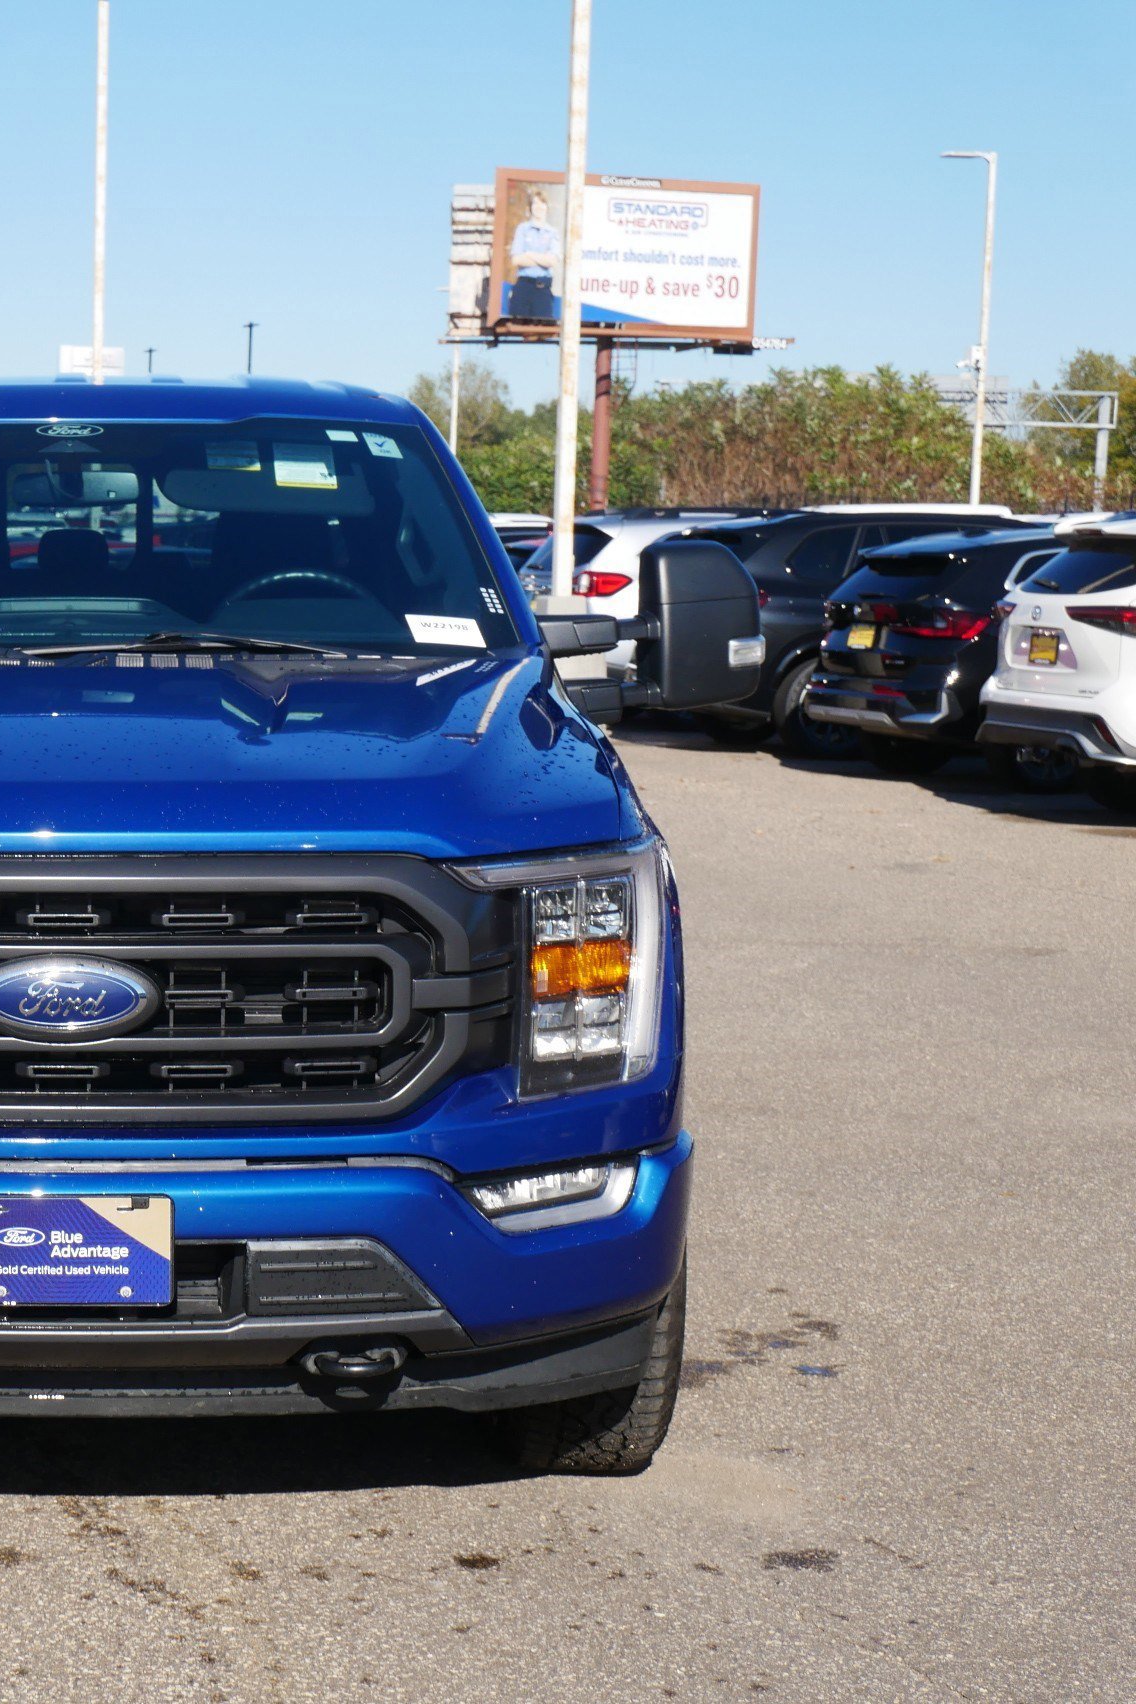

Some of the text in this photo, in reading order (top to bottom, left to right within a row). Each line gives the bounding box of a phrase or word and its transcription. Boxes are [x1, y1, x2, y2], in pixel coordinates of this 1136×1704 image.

[613, 202, 704, 218] STANDARD
[625, 217, 689, 231] HEATING
[580, 246, 741, 268] omfort shouldn't cost more.
[580, 273, 739, 299] une-up & save $30
[48, 424, 92, 435] Ford
[19, 979, 106, 1017] Ford
[3, 1229, 83, 1244] Ford Blue
[50, 1244, 129, 1260] Advantage
[20, 1264, 63, 1275] Certified
[65, 1264, 91, 1275] Used
[93, 1264, 129, 1275] Vehicle
